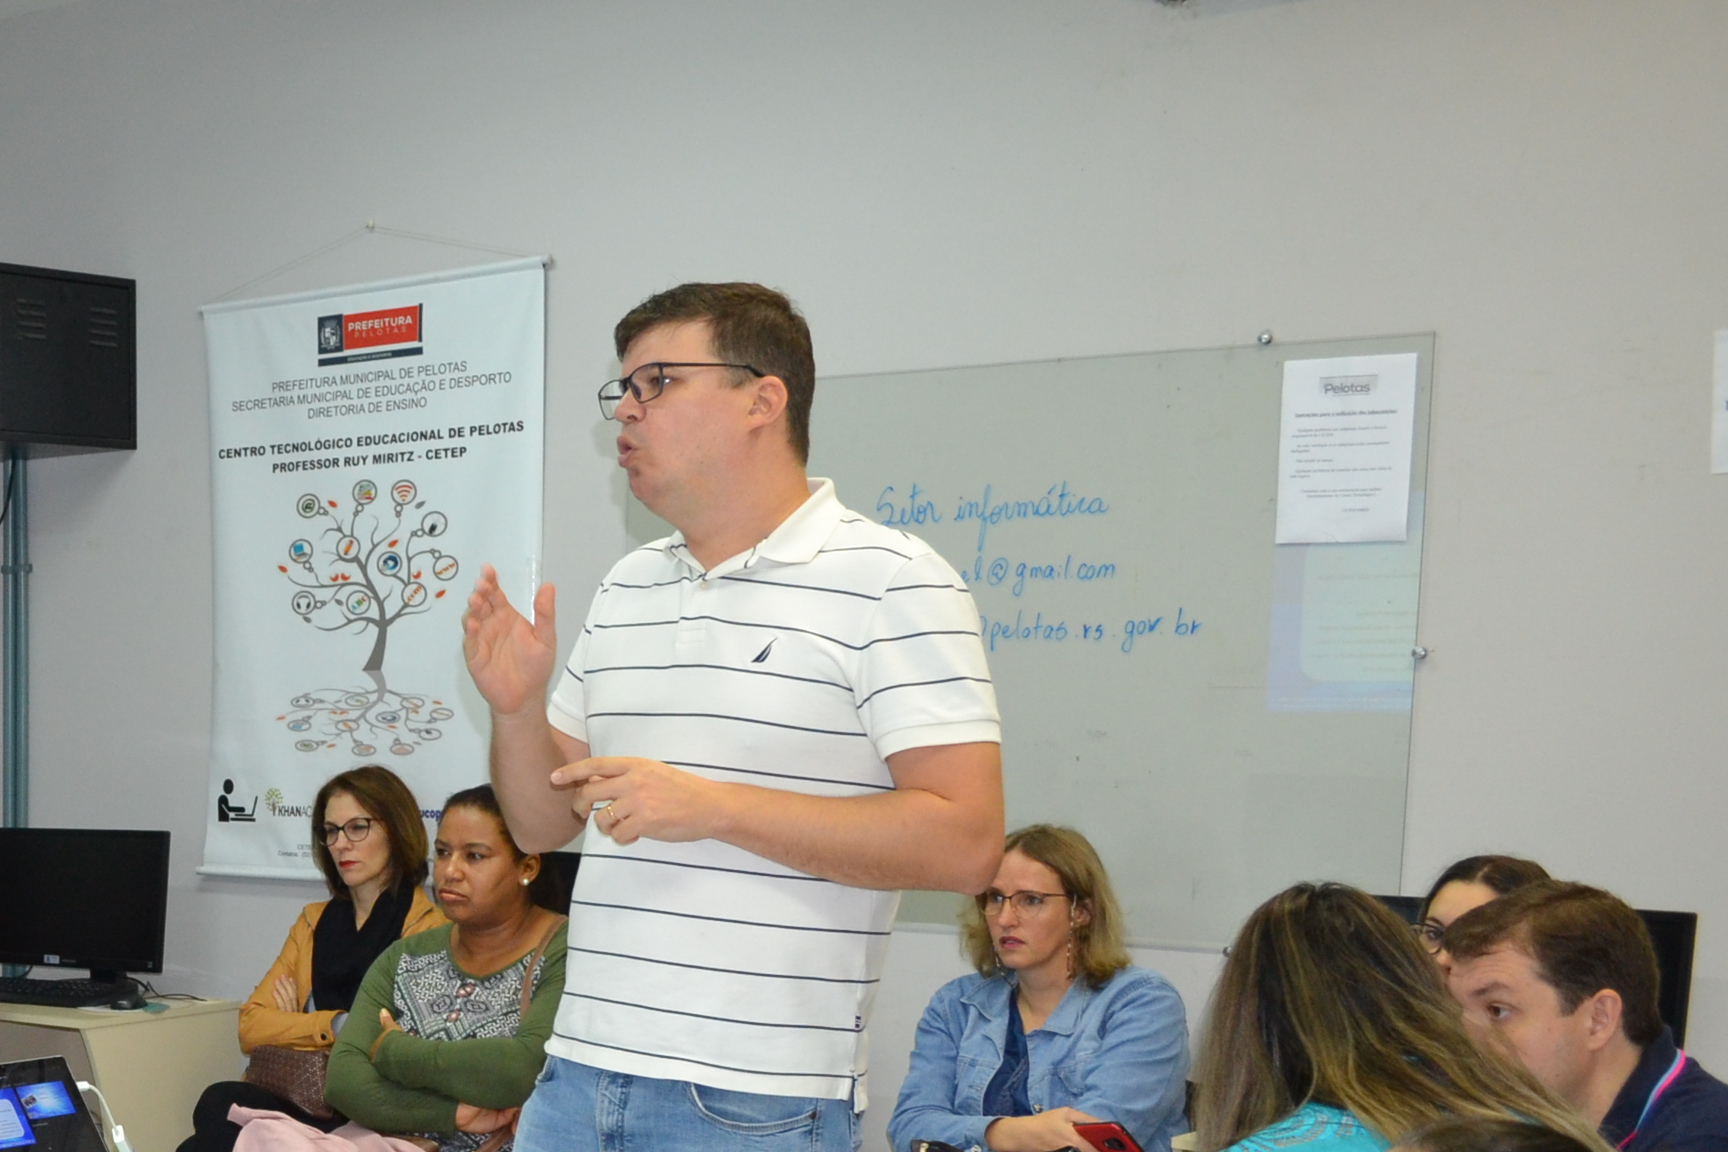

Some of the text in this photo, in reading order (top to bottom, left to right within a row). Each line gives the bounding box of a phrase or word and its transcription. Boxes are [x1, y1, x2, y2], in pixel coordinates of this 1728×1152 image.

[348, 315, 413, 331] PREFEITURA
[354, 326, 407, 338] PELOTAS
[272, 360, 468, 393] PREFEITURA MUNICIPAL DE PELOTAS
[1324, 383, 1370, 395] Pelotas
[232, 371, 512, 412] SECRETARIA MUNICIPAL DE EDUCAÇÃO E DESPORTO
[307, 396, 427, 419] DIRETORIA DE ENSINO
[218, 420, 524, 459] CENTRO TECNOLÓGICO EDUCACIONAL DE PELOTAS
[272, 457, 340, 473] PROFESSOR
[344, 455, 369, 467] RUY
[372, 451, 414, 465] MIRITZ
[425, 446, 467, 460] CETEP
[877, 480, 1109, 551] Setor informática
